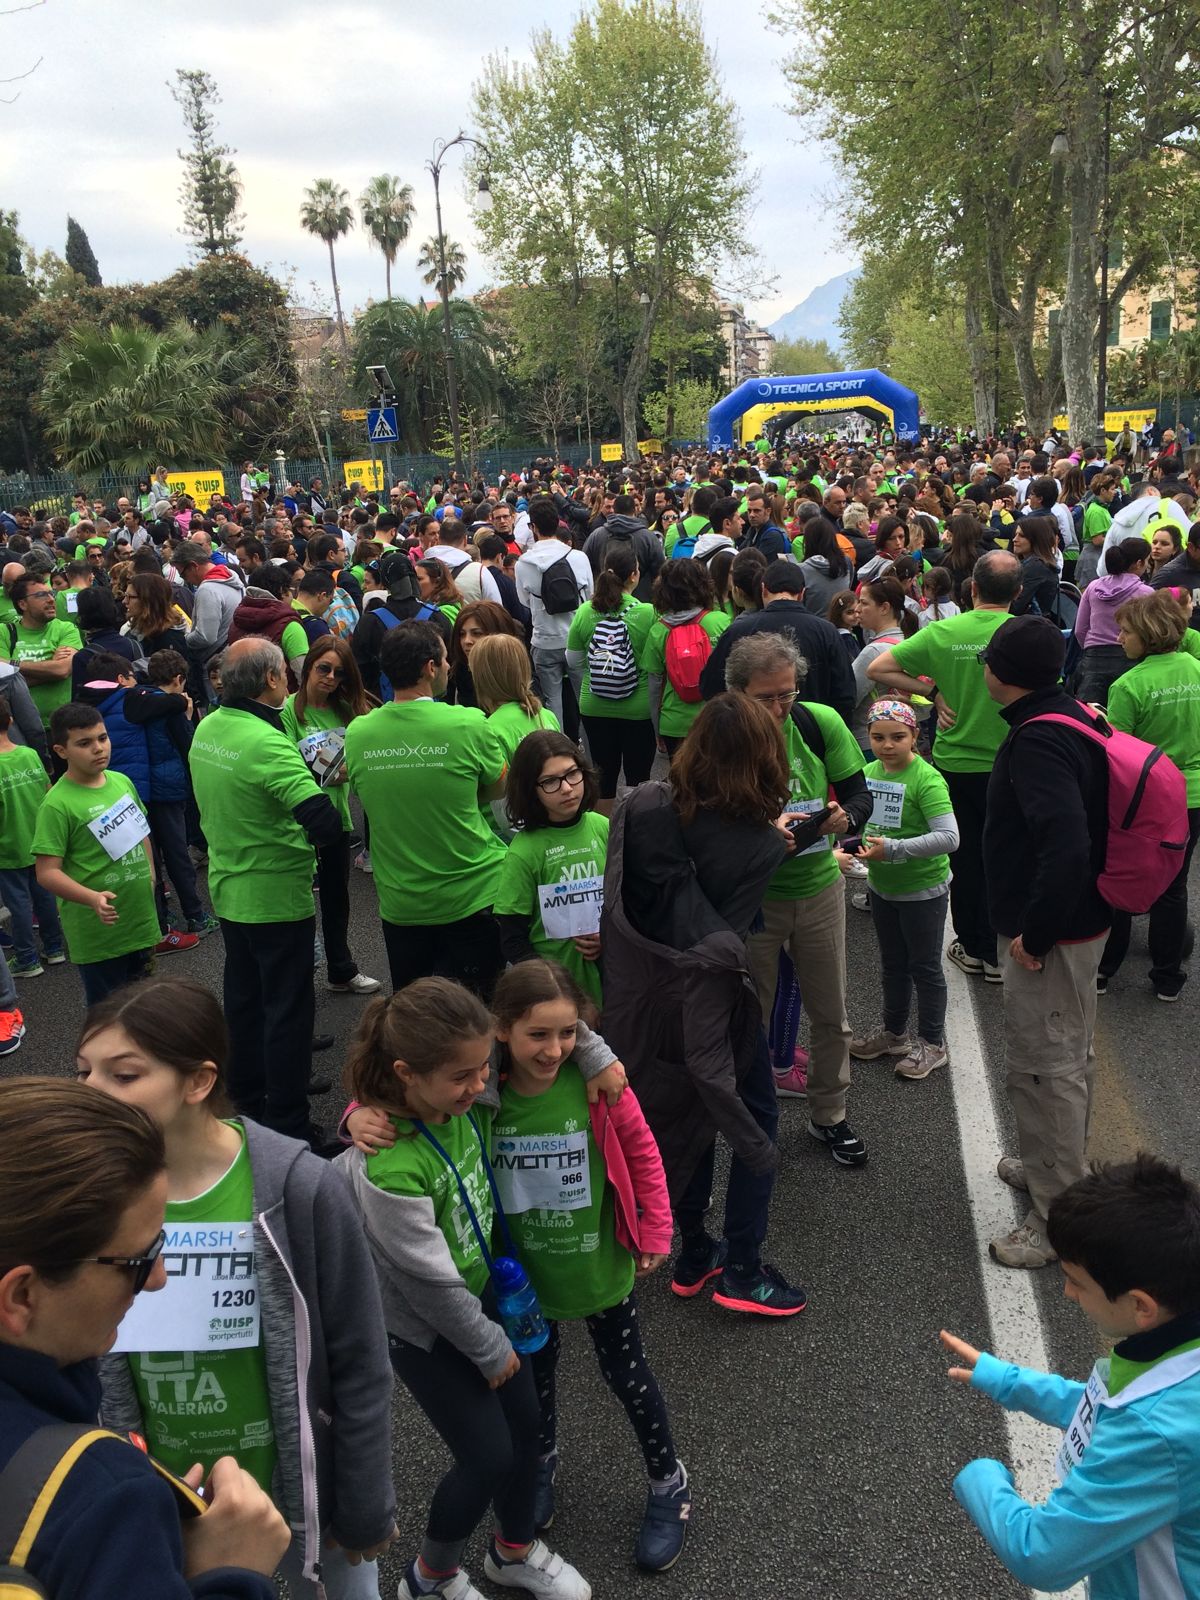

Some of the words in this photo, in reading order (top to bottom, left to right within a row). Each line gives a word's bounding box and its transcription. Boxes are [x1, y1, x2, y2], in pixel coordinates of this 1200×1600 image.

[773, 383, 824, 395] TECNICA
[825, 379, 866, 391] SPORT
[203, 480, 220, 492] UISP
[363, 747, 406, 759] DIAMOND
[420, 746, 448, 755] CARD
[884, 805, 900, 813] 2503
[569, 881, 597, 891] MARSH
[496, 1127, 517, 1135] UISP
[520, 1140, 567, 1152] MARSH
[561, 1172, 582, 1185] 966
[567, 1188, 586, 1197] UISP
[521, 1216, 574, 1228] PALERMO
[164, 1231, 233, 1247] MARSH
[211, 1289, 255, 1308] 1230
[223, 1317, 254, 1328] UISP
[208, 1331, 253, 1342] sportpertutti
[149, 1400, 228, 1416] PALERMO
[199, 1429, 237, 1439] DIADORA
[1070, 1427, 1085, 1458] 970
